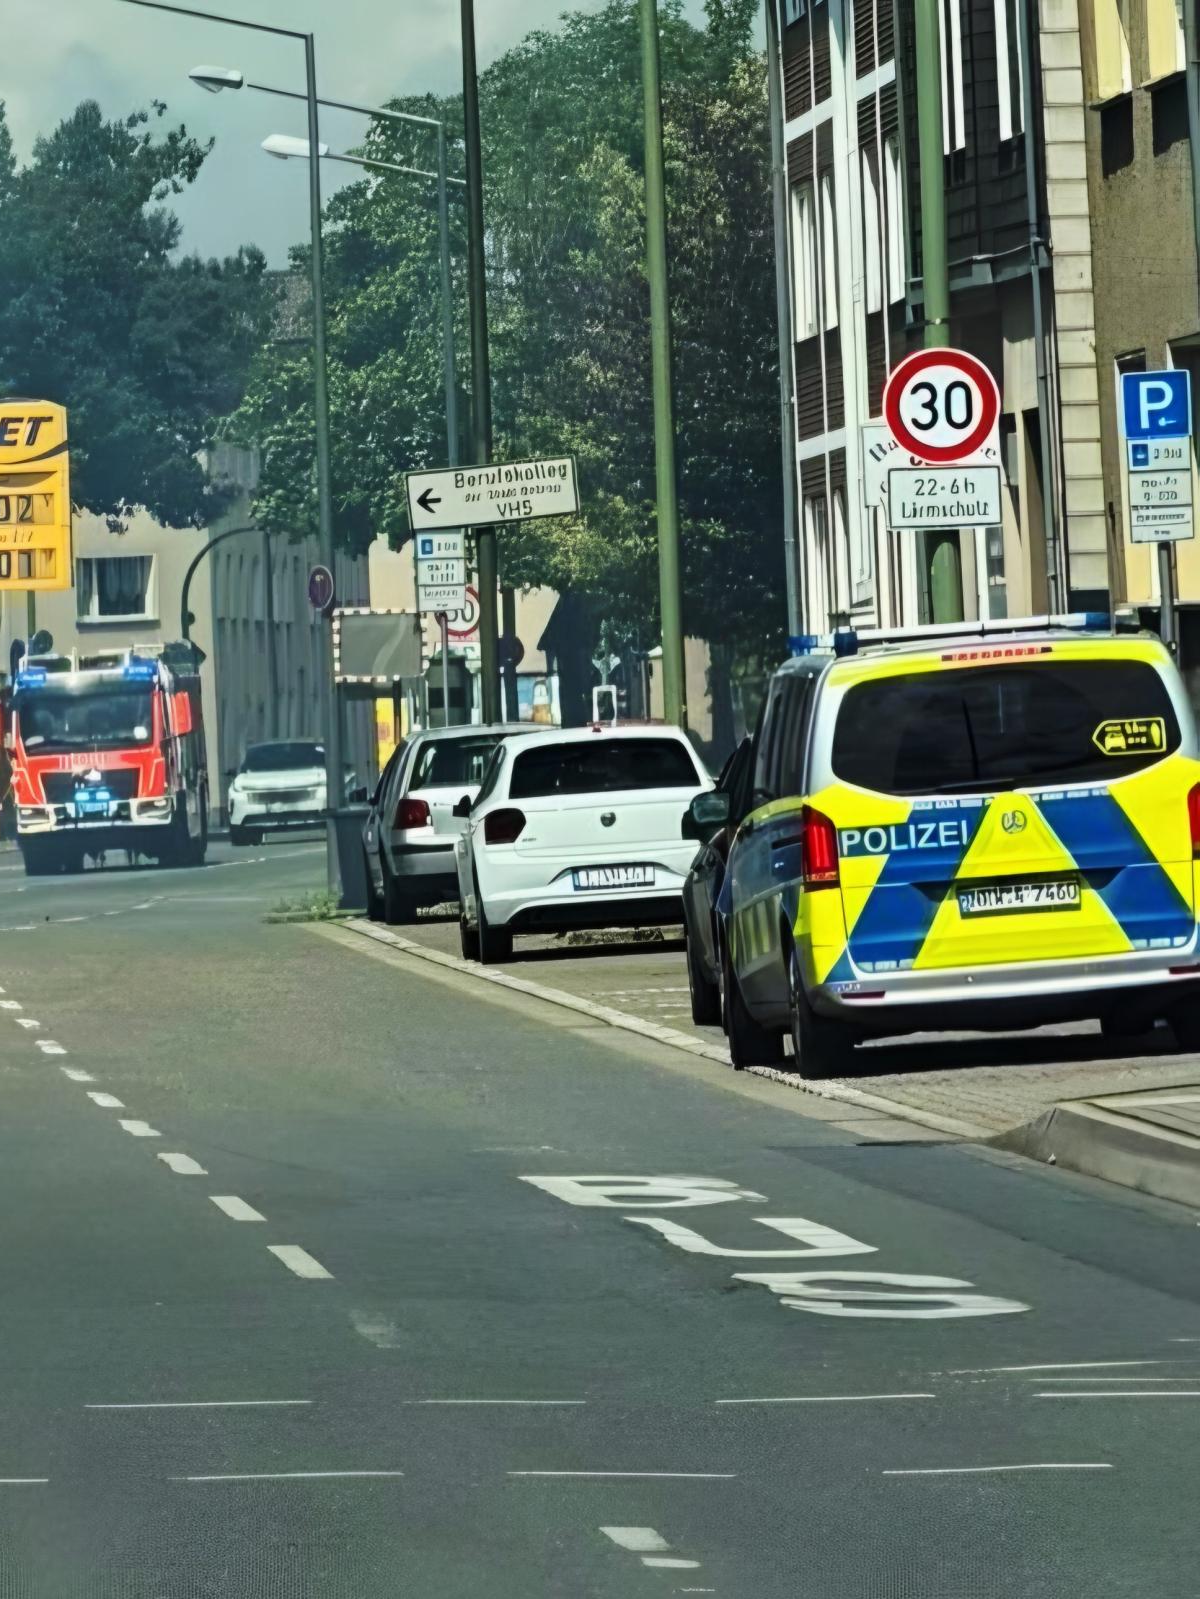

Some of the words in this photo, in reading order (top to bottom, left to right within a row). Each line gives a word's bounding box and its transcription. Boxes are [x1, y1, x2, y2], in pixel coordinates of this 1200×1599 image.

[910, 380, 973, 430] 30
[1139, 380, 1173, 429] P
[841, 820, 968, 856] POLIZEI
